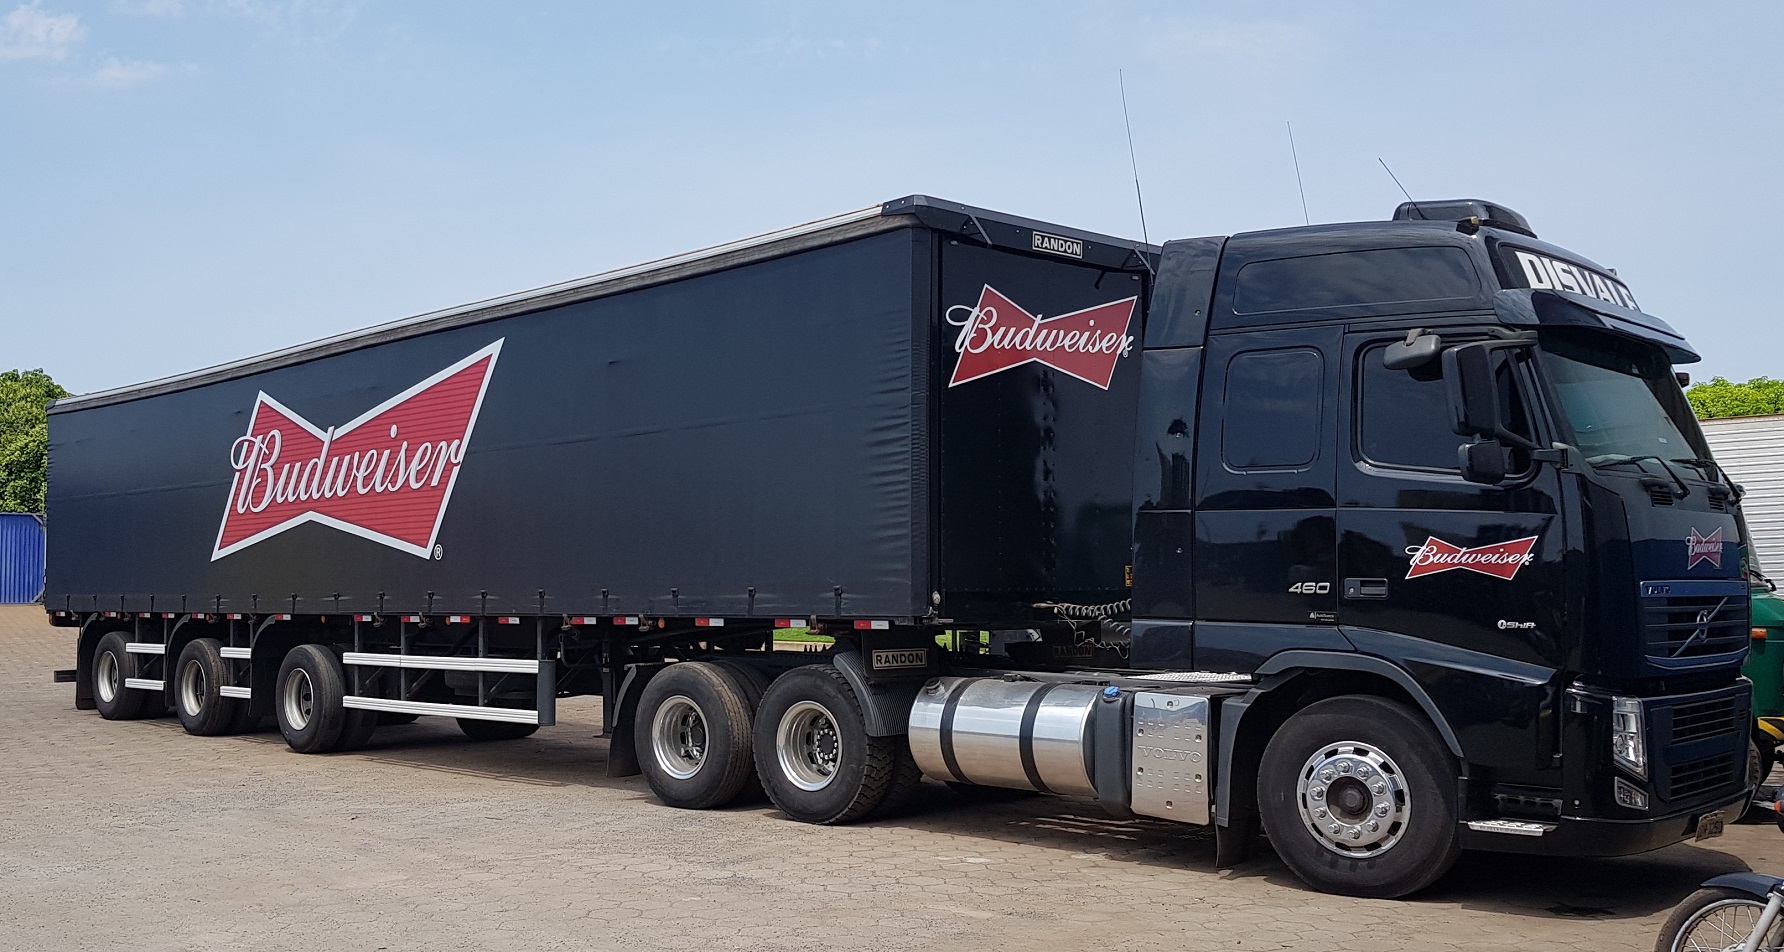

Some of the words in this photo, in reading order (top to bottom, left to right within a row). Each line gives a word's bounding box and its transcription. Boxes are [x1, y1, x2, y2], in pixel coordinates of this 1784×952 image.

[1034, 234, 1081, 255] RANDON
[945, 304, 1134, 355] Budweiser
[231, 425, 462, 514] Budweiser
[1405, 545, 1534, 566] Budweiser
[1288, 582, 1331, 594] 460
[875, 652, 924, 665] RANDON
[1137, 745, 1202, 763] VOLVO
